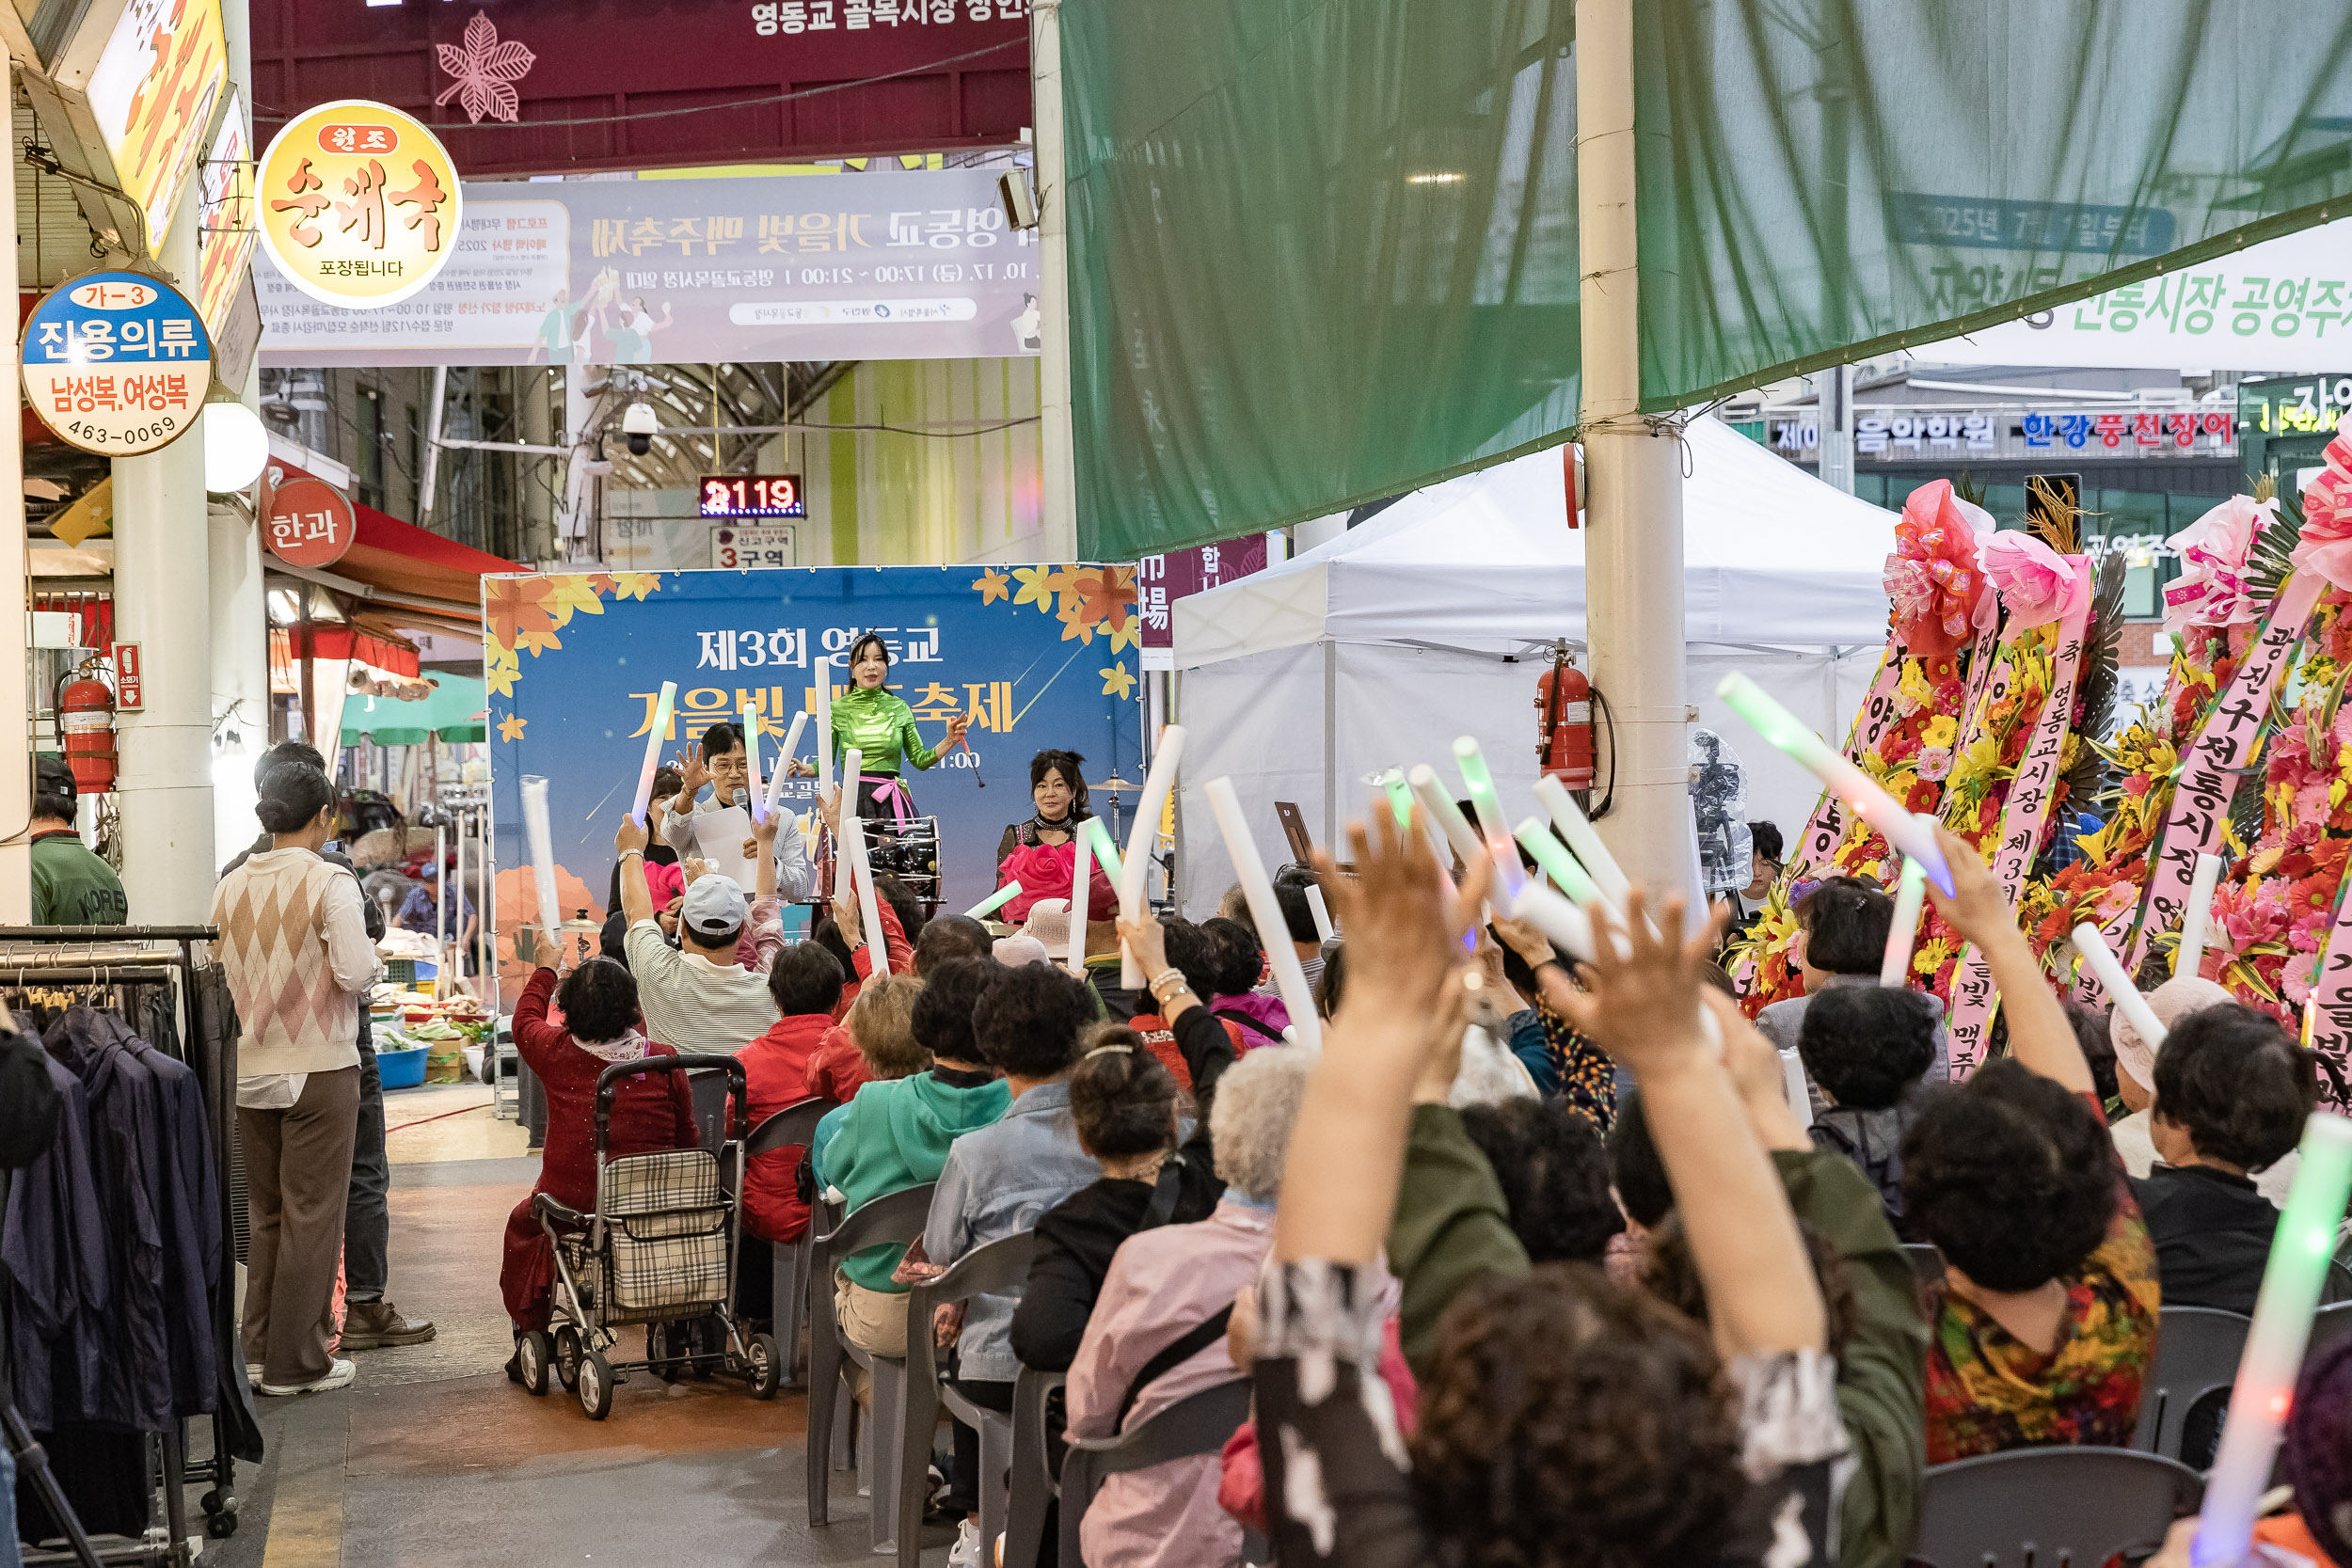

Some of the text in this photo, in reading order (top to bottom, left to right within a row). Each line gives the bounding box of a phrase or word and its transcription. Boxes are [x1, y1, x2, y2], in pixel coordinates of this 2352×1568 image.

[752, 0, 1030, 36] 영동교 골목시장 상인
[331, 127, 388, 151] 원조
[271, 158, 447, 252] 순대국
[319, 261, 404, 277] 포장됩니다
[38, 319, 199, 360] 진용의류
[68, 417, 176, 444] 463-0069
[270, 510, 339, 547] 한과
[696, 629, 807, 671] 제3회
[77, 889, 126, 920] KORE
[1950, 1023, 1981, 1079] 맥주
